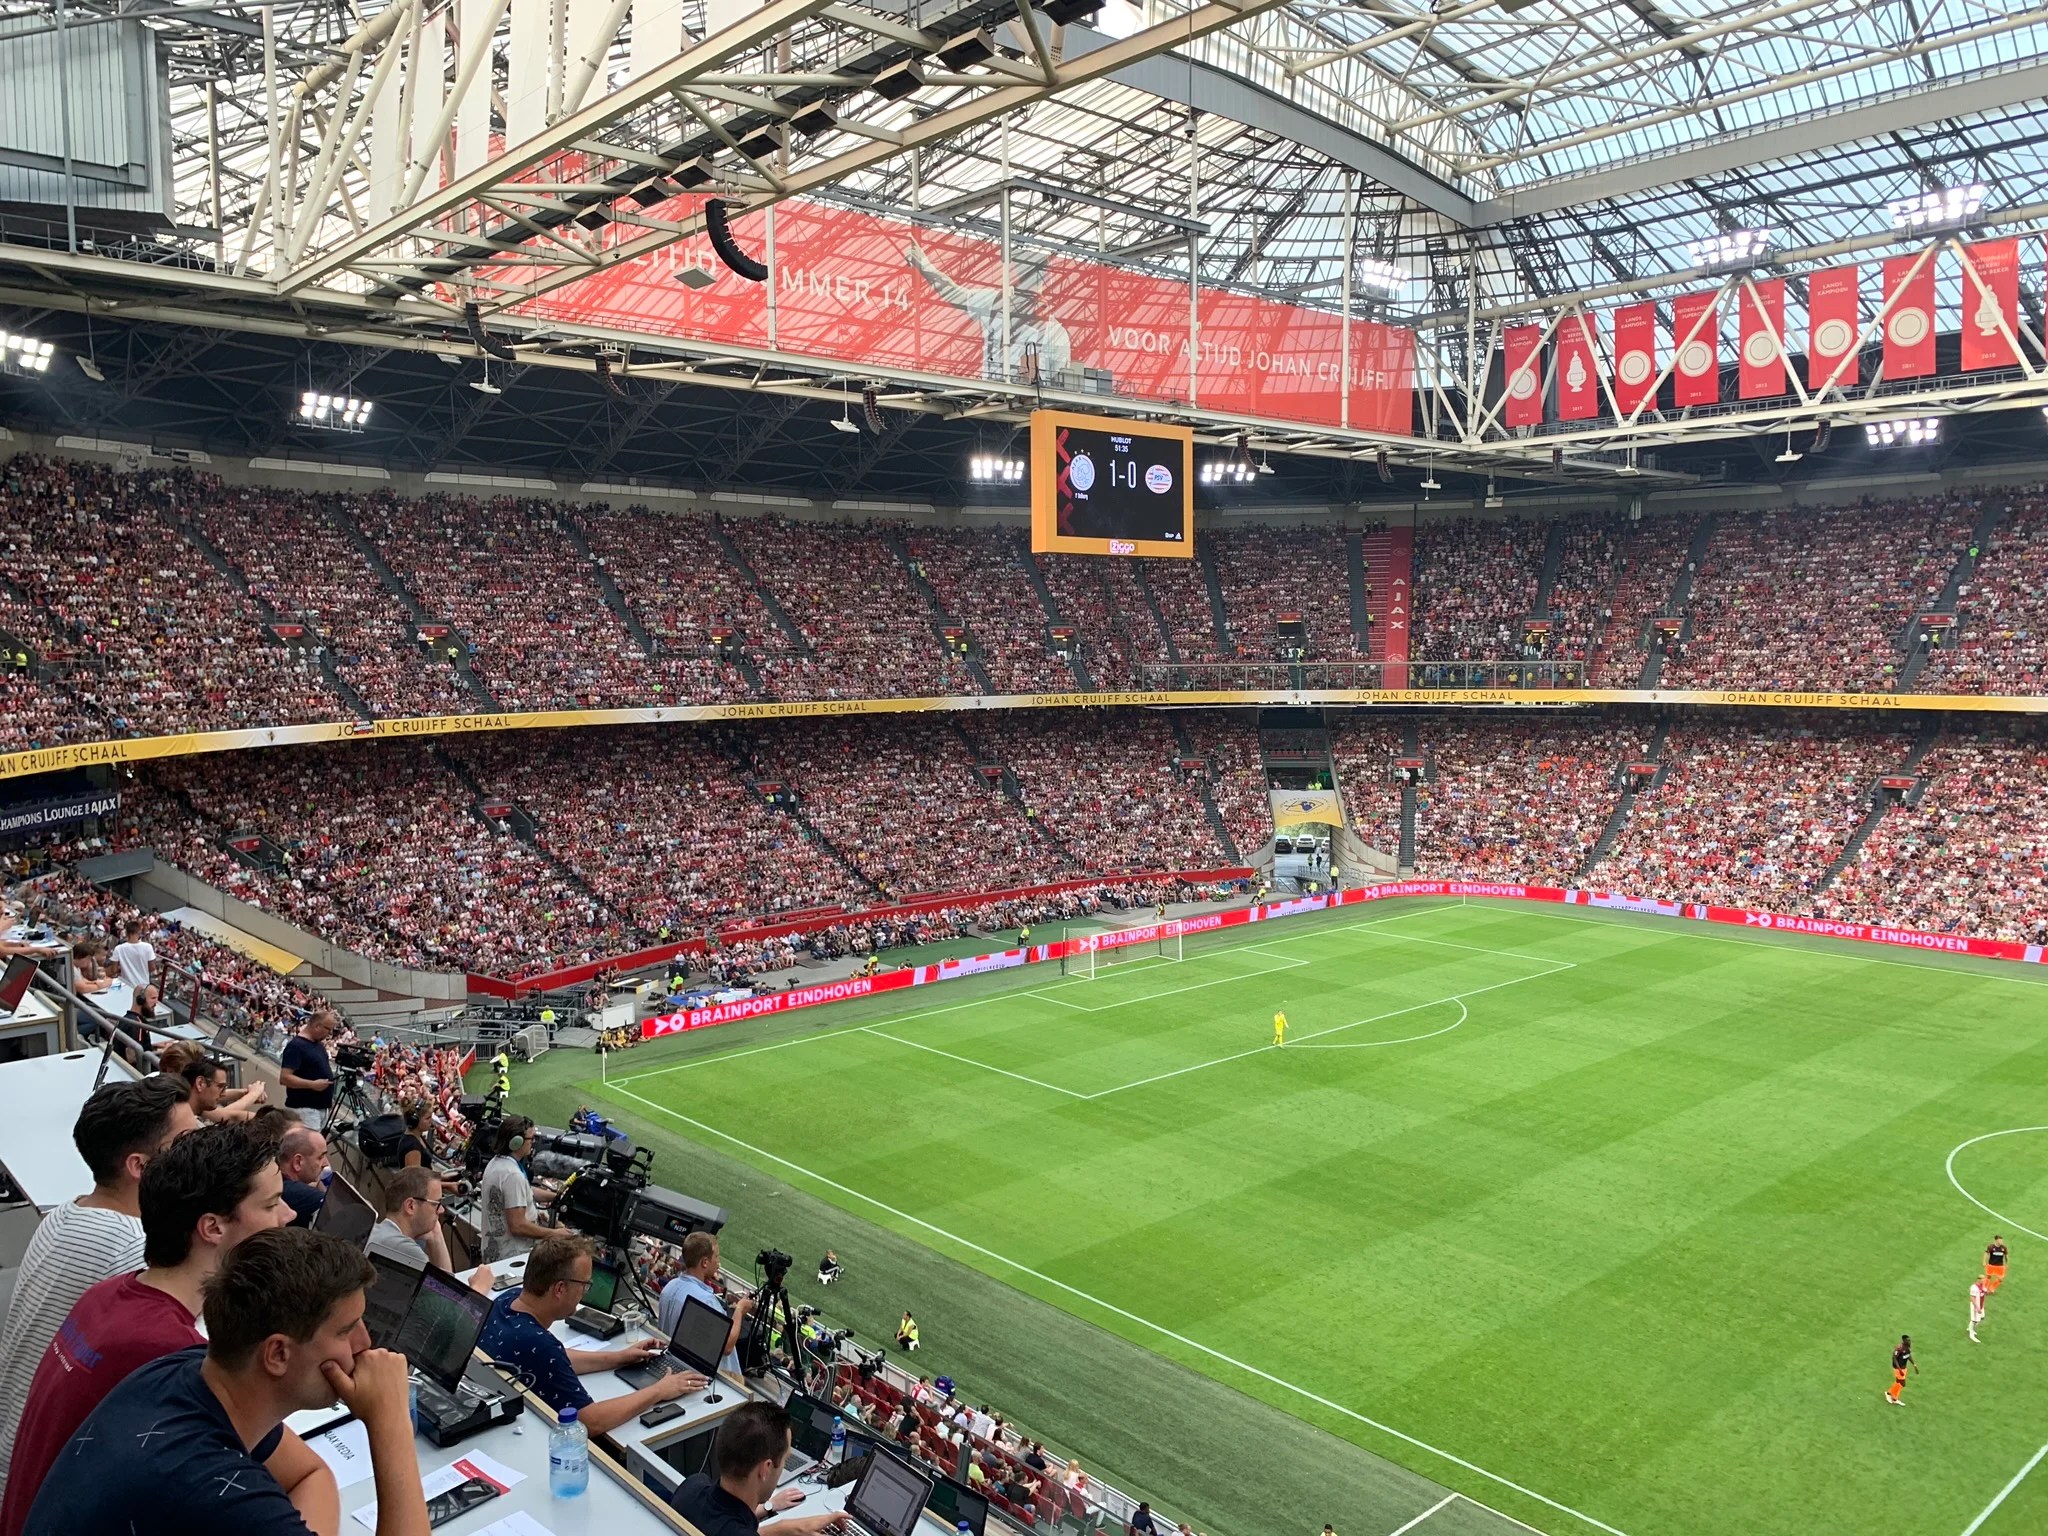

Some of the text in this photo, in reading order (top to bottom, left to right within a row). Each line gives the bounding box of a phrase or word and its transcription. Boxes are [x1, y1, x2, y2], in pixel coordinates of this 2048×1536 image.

[1817, 287, 1848, 296] KAMPIOEN
[1822, 281, 1842, 289] LANDS
[1621, 321, 1647, 329] KAMPIOEN
[1108, 325, 1170, 356] VOOR
[1179, 338, 1241, 367] ALTIJD
[1248, 350, 1311, 378] JOHAN
[1110, 436, 1132, 444] HUBLOT
[1109, 459, 1137, 489] 1-0
[1110, 540, 1136, 554] Ziggo
[1390, 578, 1406, 629] AJAX
[1031, 692, 1171, 705] JOHAN CRUIJFF SCHAAL
[1355, 691, 1513, 700] JOHAN CRUIJFF SCHAAL
[1720, 693, 1901, 707] JOHAN CRUIJFF SCHAAL
[721, 701, 867, 718] JOHAN CRUIJFF SCHAAL
[337, 722, 386, 736] JON
[391, 718, 447, 733] CRUIJFF
[454, 715, 511, 729] SCHAAL
[21, 749, 68, 770] CRUIJFF
[73, 744, 127, 762] SCHAAL
[0, 812, 42, 830] HAMPIONS
[91, 798, 117, 815] AJAX
[1381, 882, 1526, 897] BRAINPORT EINDHOVEN
[1165, 915, 1222, 936] EINDHOVEN
[1776, 917, 1968, 951] BRAINPORT EINDHOVEN
[690, 979, 872, 1026] BRAINPORT EINDHOVEN
[334, 1442, 355, 1460] MEDIA
